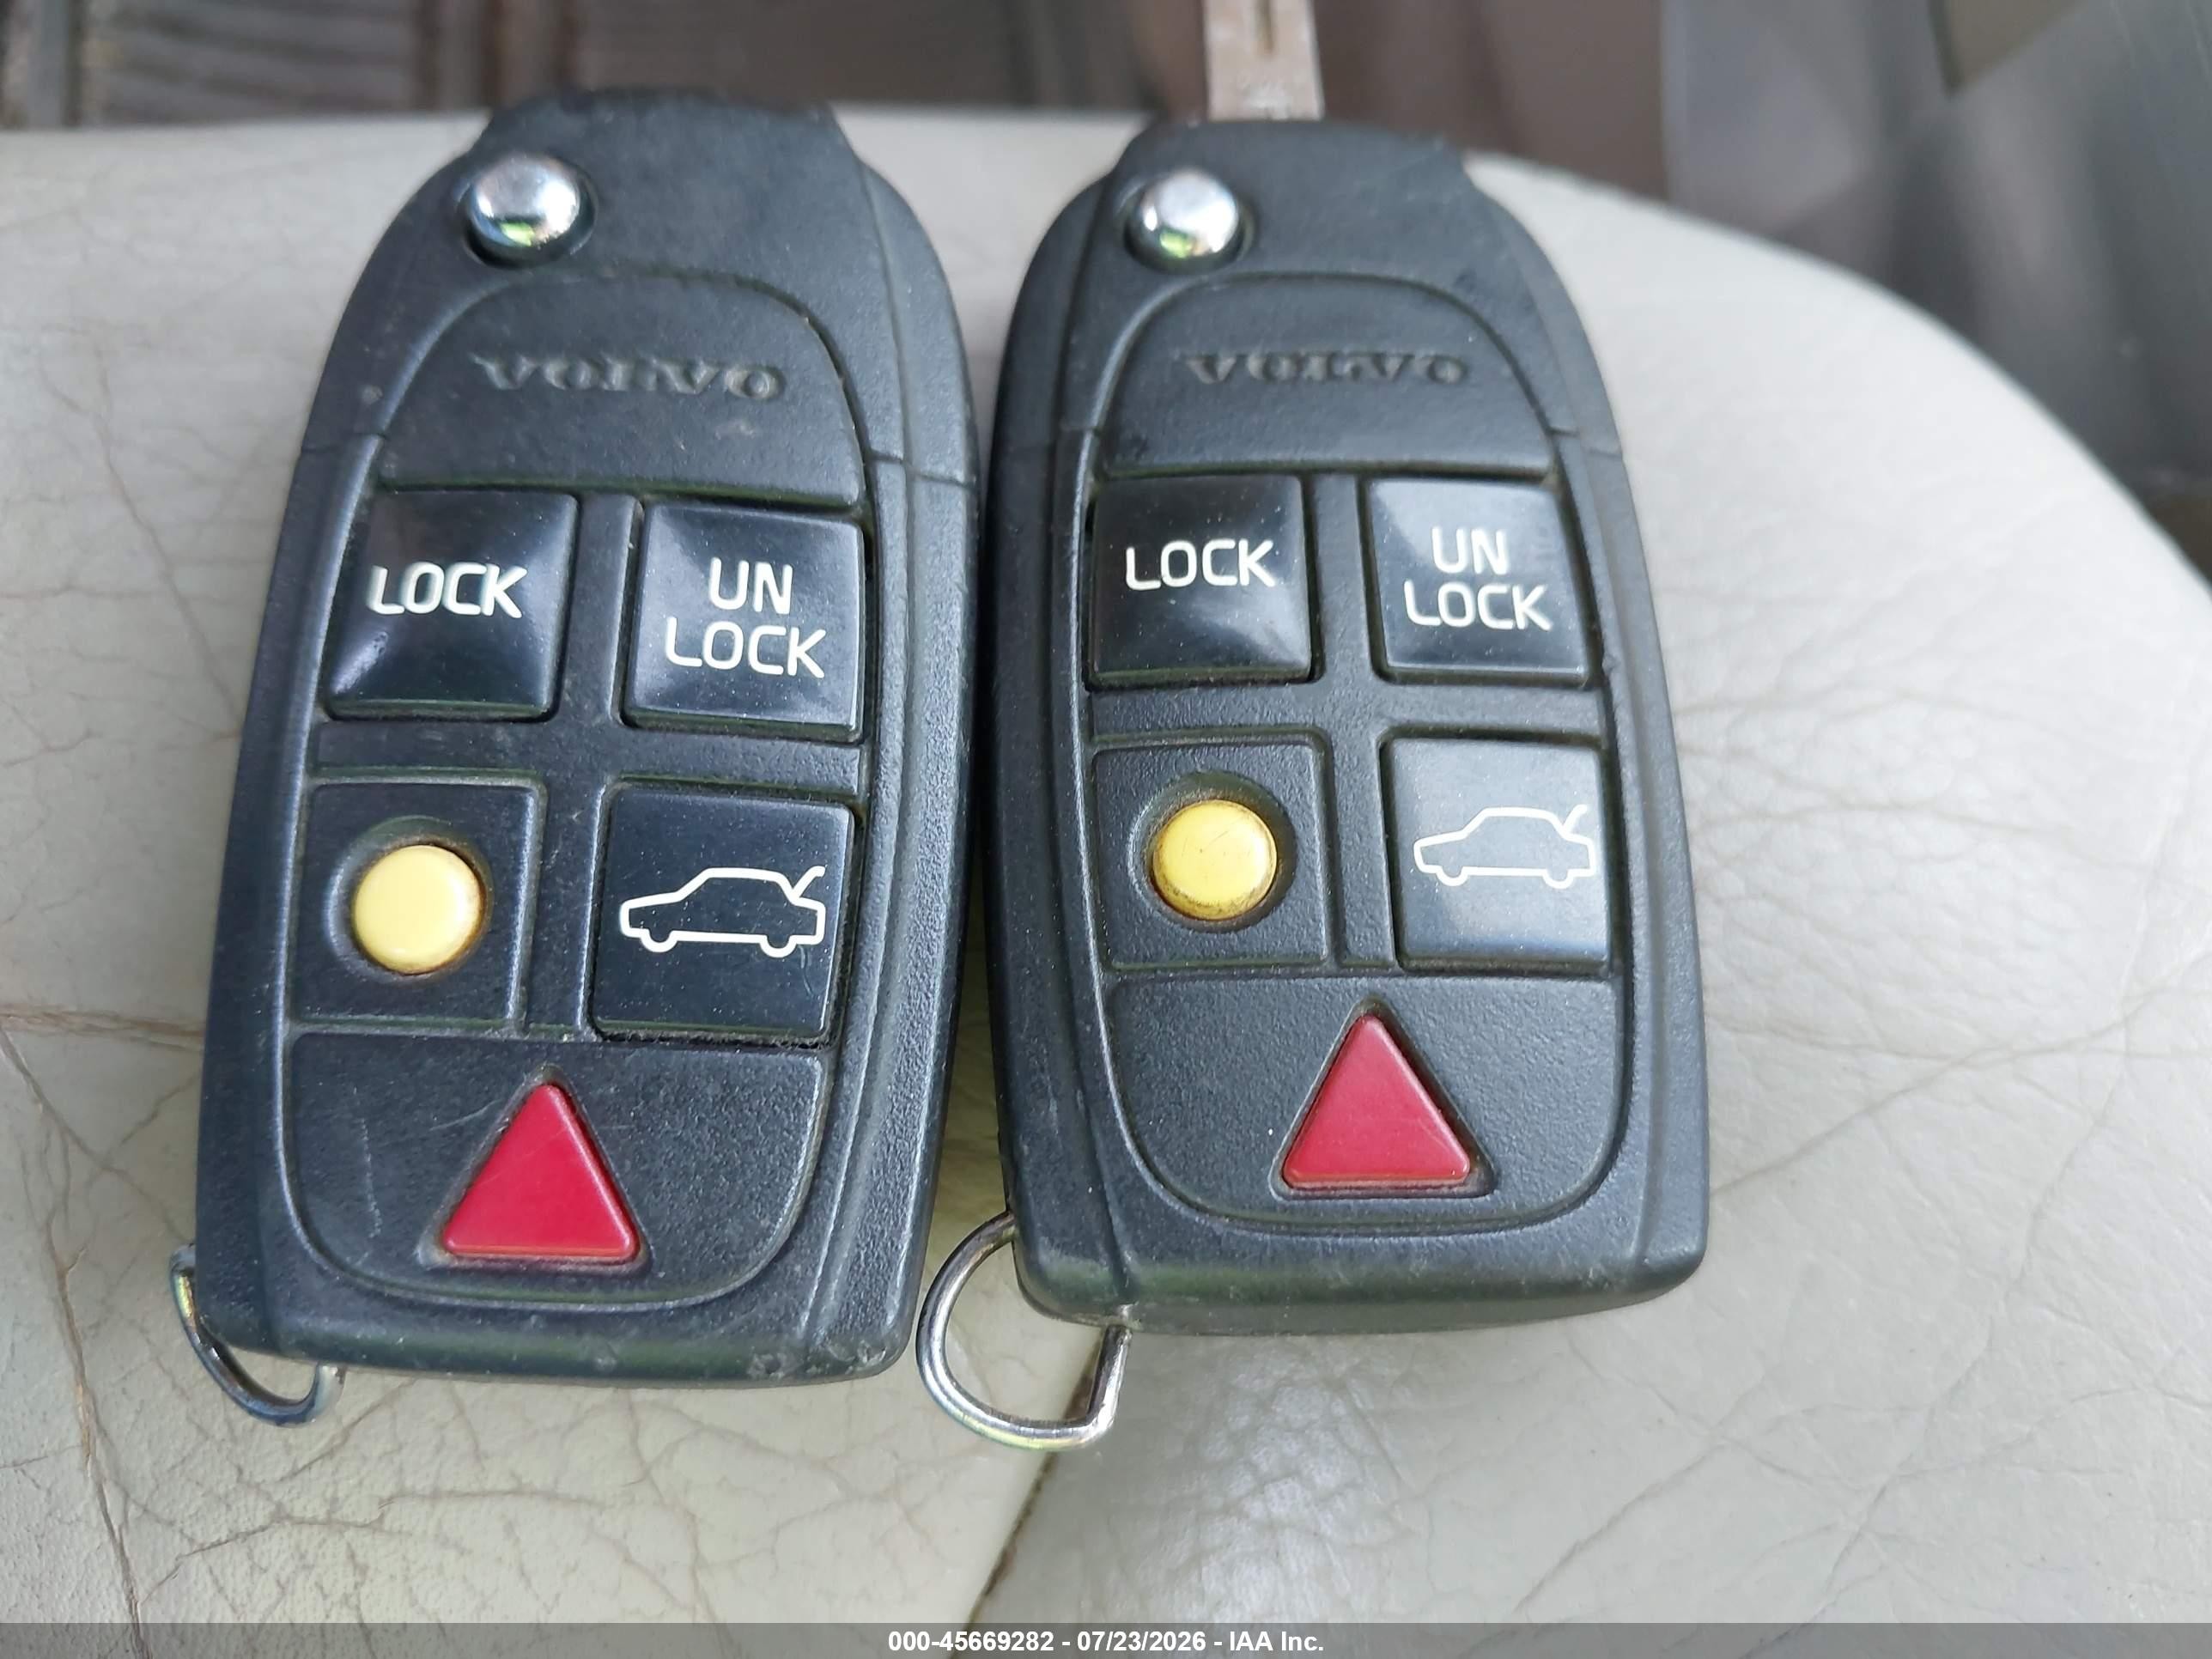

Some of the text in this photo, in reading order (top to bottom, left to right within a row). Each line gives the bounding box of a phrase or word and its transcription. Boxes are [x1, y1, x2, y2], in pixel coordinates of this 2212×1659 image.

[470, 352, 785, 400] VOLVO
[1185, 349, 1470, 386] VOLVO
[1125, 538, 1277, 591] LOCK
[1431, 526, 1510, 575] UN
[367, 562, 528, 618] LOCK
[708, 557, 793, 615] UN
[1403, 580, 1553, 630] LOCK
[665, 616, 827, 678] LOCK
